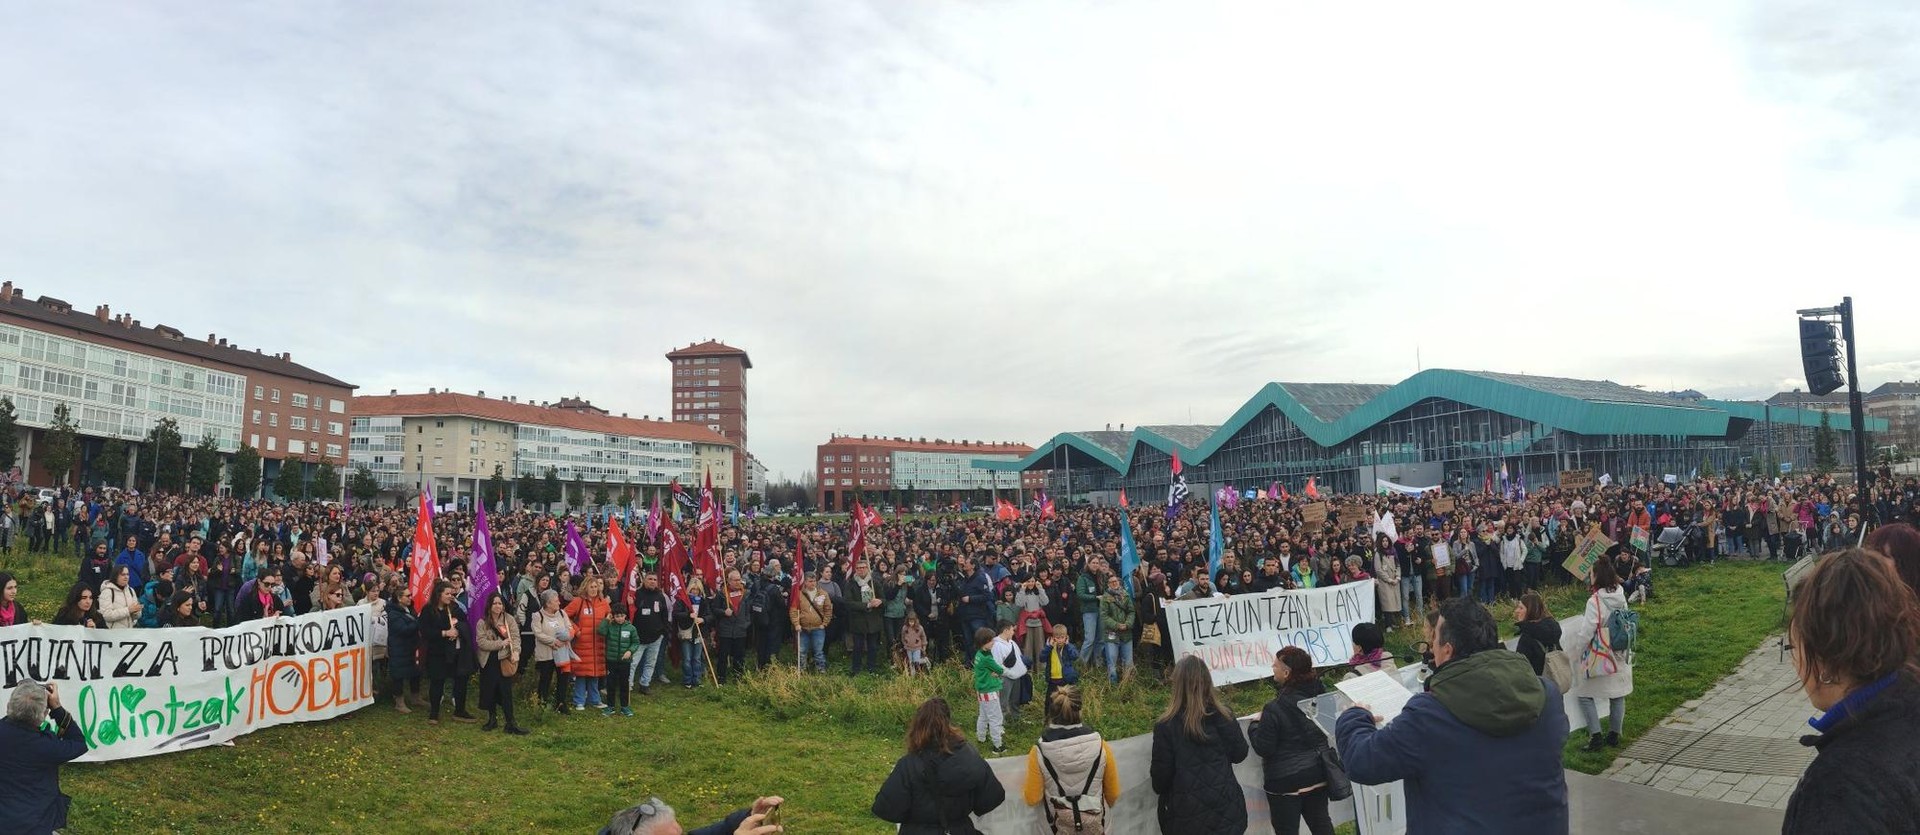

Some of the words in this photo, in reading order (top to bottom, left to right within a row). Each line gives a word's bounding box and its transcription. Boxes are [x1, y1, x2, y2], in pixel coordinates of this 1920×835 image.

[1177, 595, 1312, 641] HEZKUNTZAN
[1325, 587, 1362, 625] LAN
[0, 637, 179, 689] KUNTZA
